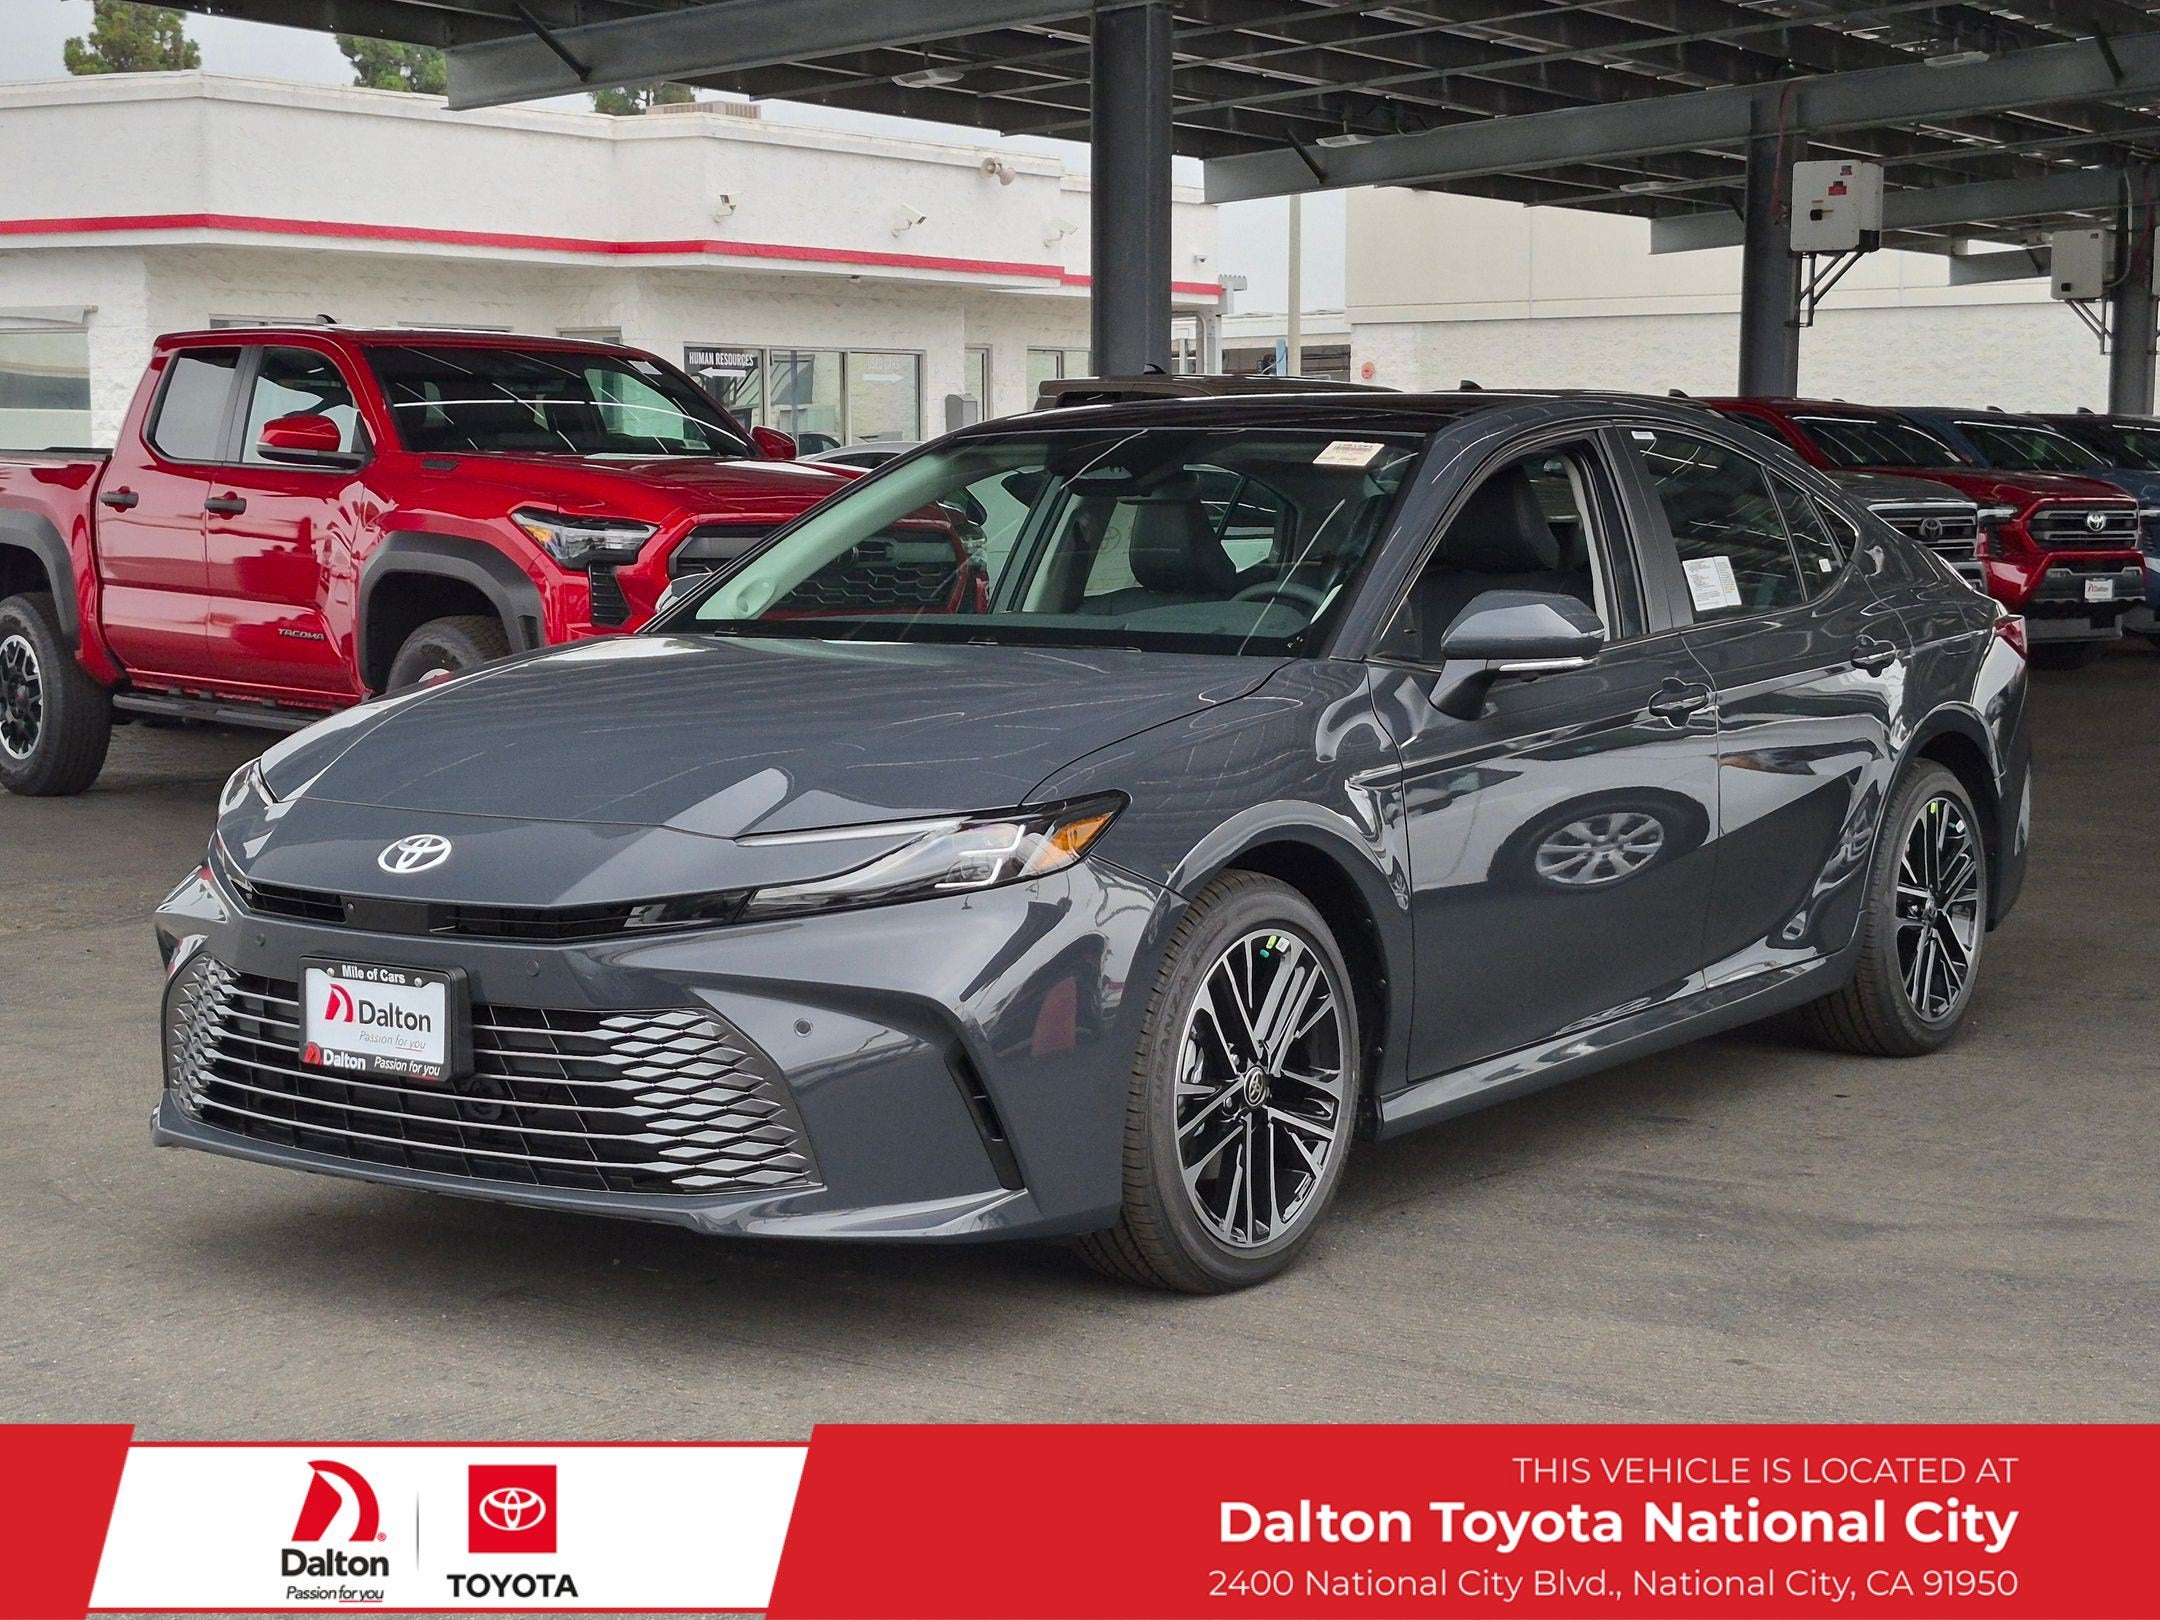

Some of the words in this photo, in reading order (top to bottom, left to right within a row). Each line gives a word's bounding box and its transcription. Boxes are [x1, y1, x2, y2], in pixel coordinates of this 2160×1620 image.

[689, 352, 714, 365] HUMAN
[715, 352, 754, 366] RESOURCES
[278, 628, 325, 640] TACOMA
[341, 964, 364, 979] Mile
[366, 968, 378, 980] of
[379, 970, 406, 984] Cars
[358, 999, 431, 1032] Dalton
[359, 1030, 393, 1046] Passion
[394, 1034, 409, 1048] for
[409, 1040, 426, 1051] you
[323, 1048, 366, 1071] Dalton
[374, 1056, 407, 1072] Passion
[408, 1063, 422, 1074] for
[422, 1064, 440, 1078] you
